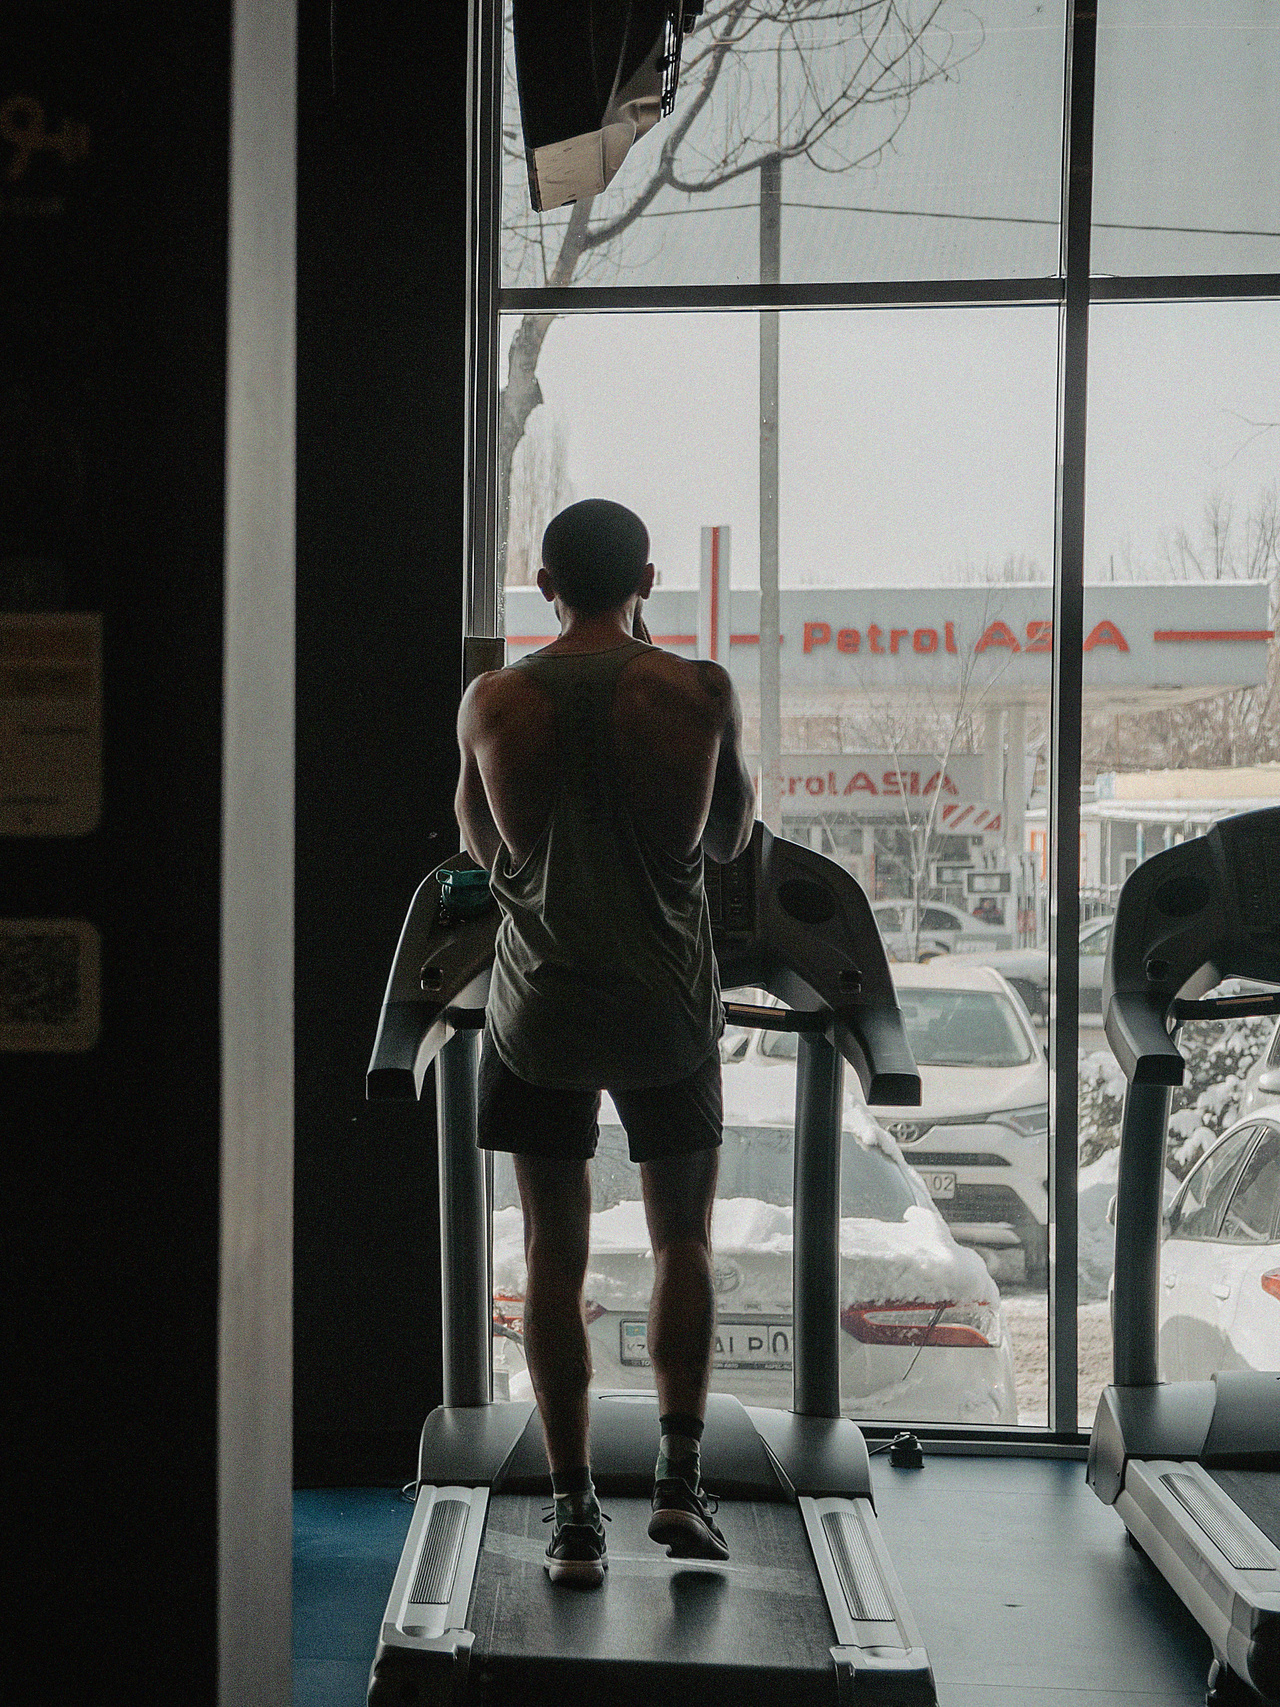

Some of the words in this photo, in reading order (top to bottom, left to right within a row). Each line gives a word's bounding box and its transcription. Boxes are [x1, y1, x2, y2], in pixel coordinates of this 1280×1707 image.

[802, 620, 958, 655] Petrol
[974, 619, 1131, 655] ASA
[843, 770, 960, 796] ASIA
[933, 1175, 955, 1192] 02
